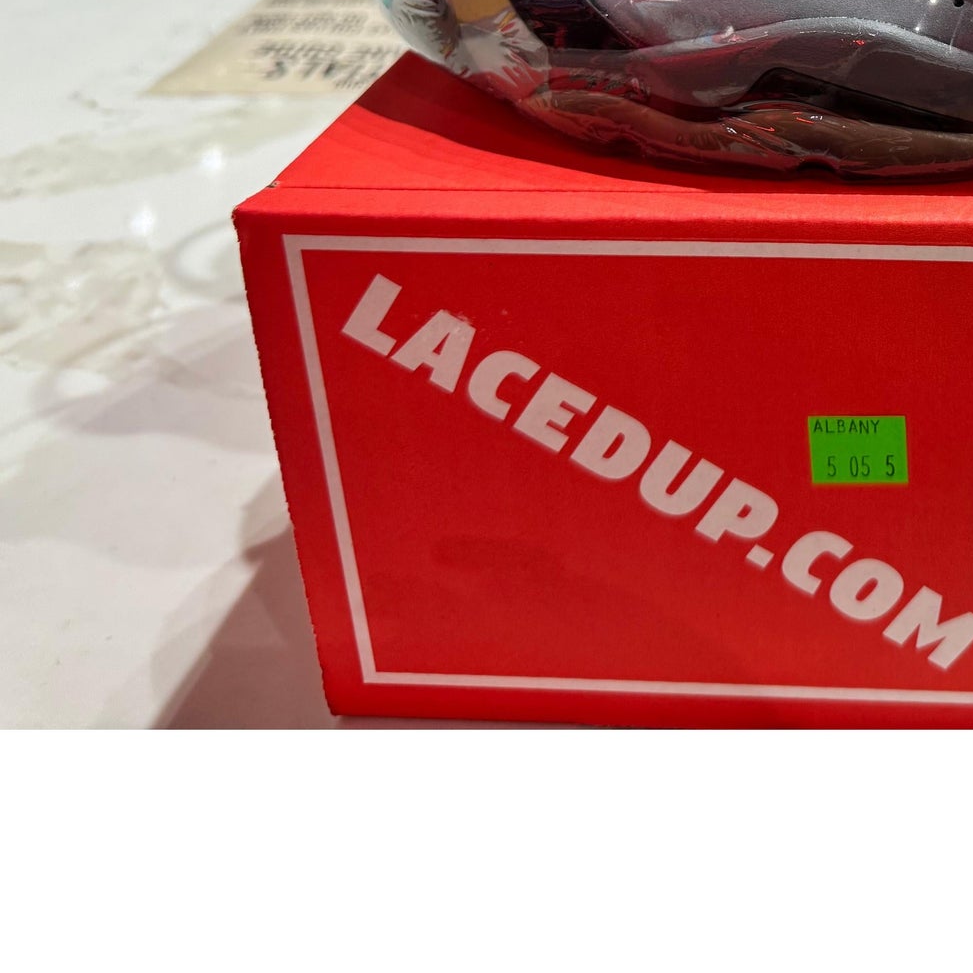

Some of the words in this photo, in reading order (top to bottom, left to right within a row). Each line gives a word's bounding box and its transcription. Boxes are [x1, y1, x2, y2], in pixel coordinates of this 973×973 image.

[813, 419, 880, 435] ALBANY
[827, 455, 837, 477] 5
[849, 455, 871, 477] 05
[885, 454, 895, 477] 5
